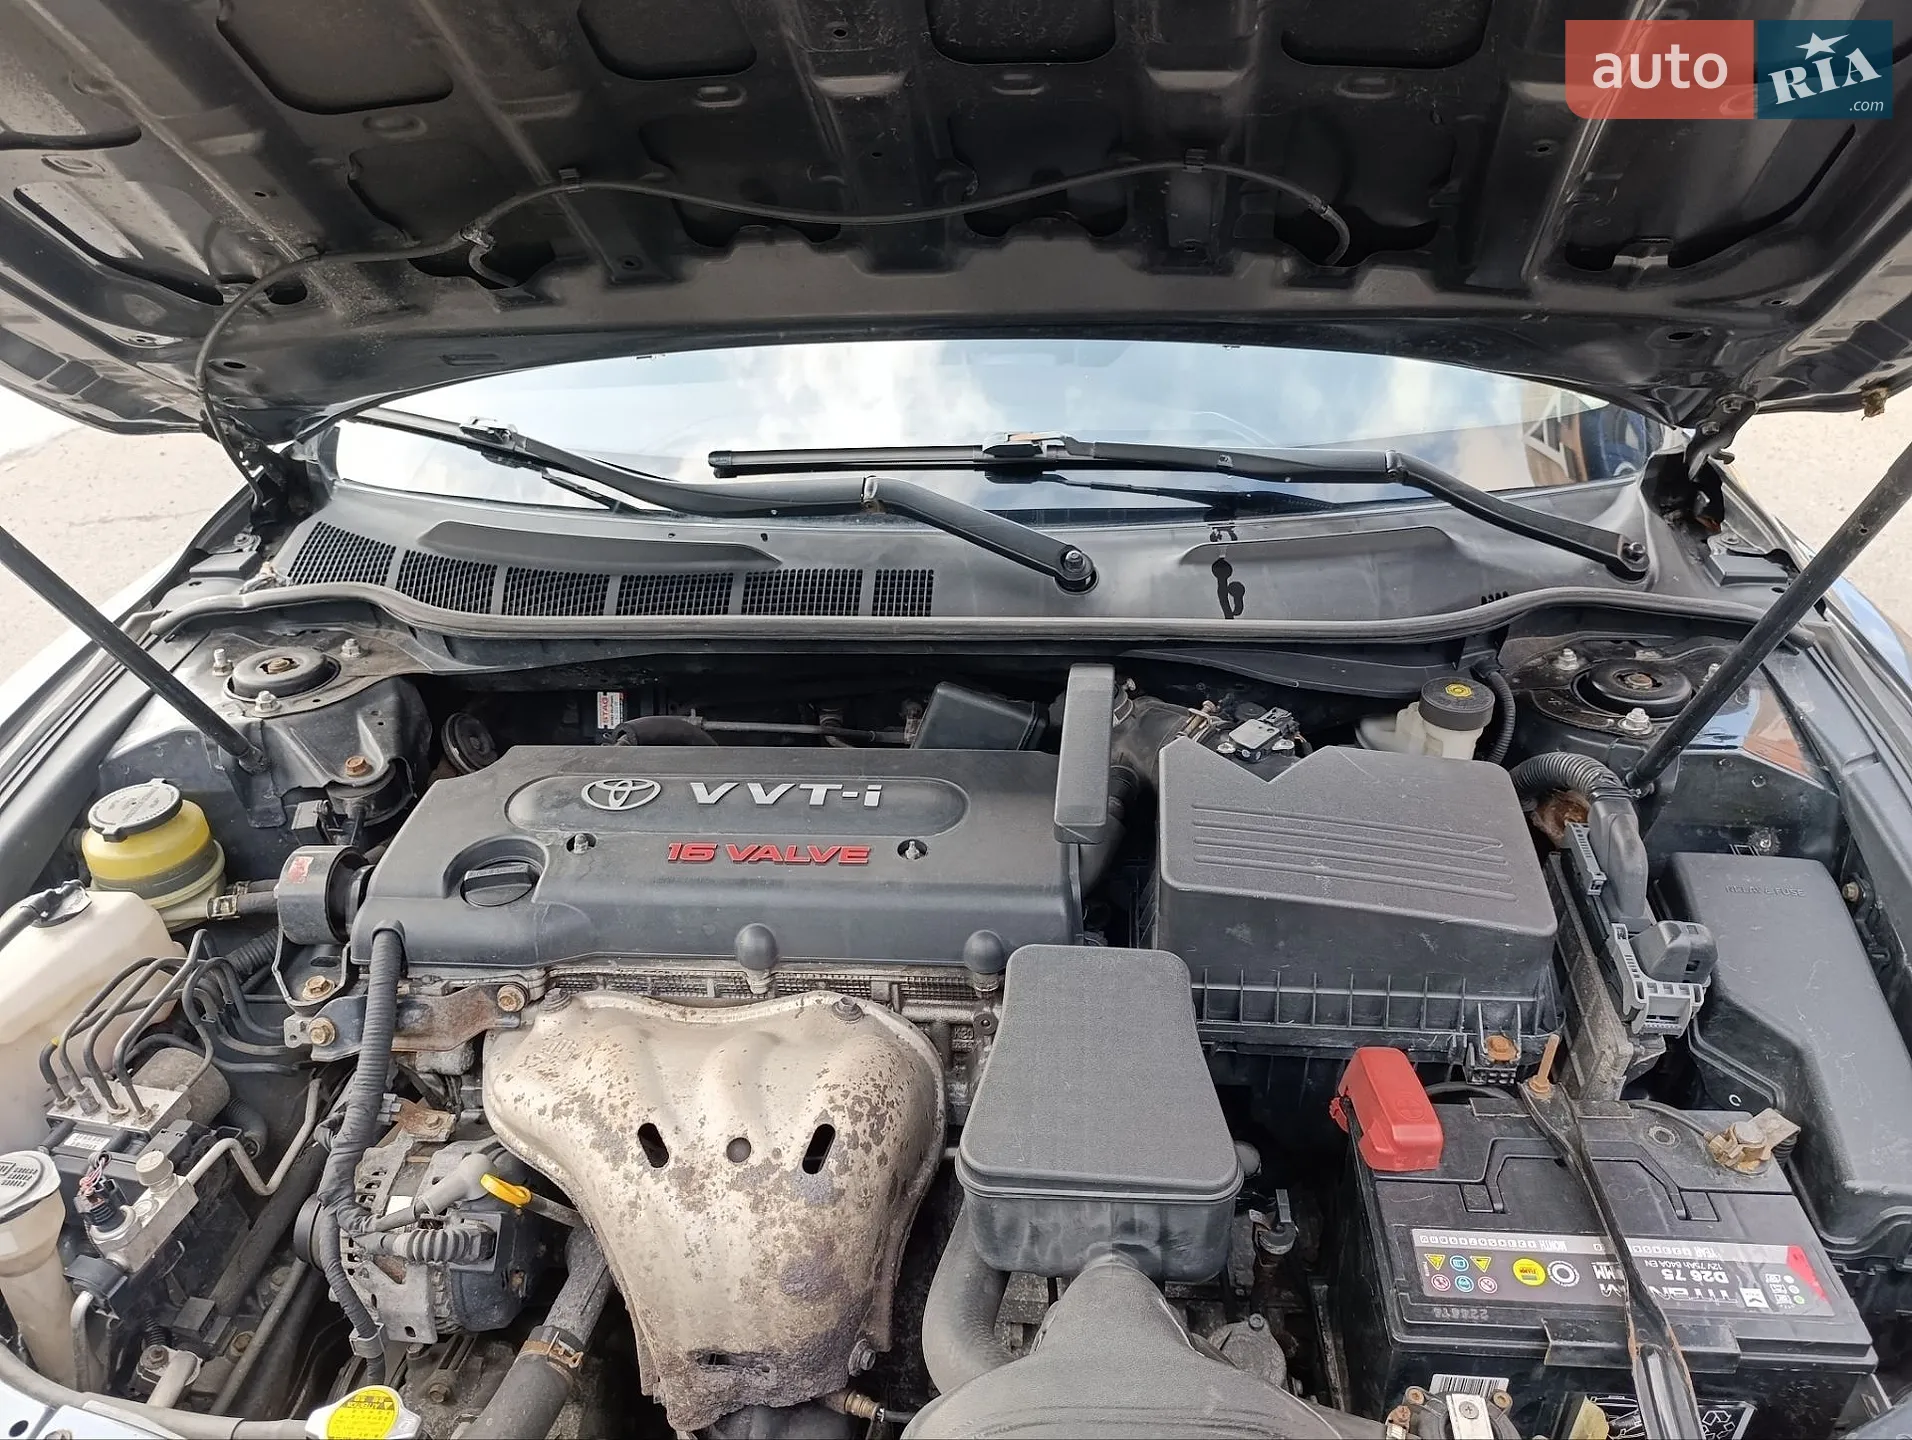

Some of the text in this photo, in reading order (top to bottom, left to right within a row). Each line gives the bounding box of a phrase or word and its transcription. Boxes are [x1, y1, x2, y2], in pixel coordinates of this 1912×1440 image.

[690, 782, 883, 807] VVT-i
[667, 842, 872, 864] 16 VALVE
[1774, 887, 1805, 897] FUSE
[1645, 1259, 1657, 1267] EN
[1683, 1261, 1705, 1269] 75Ah
[1707, 1263, 1723, 1271] 12V
[1661, 1268, 1729, 1284] D26 75
